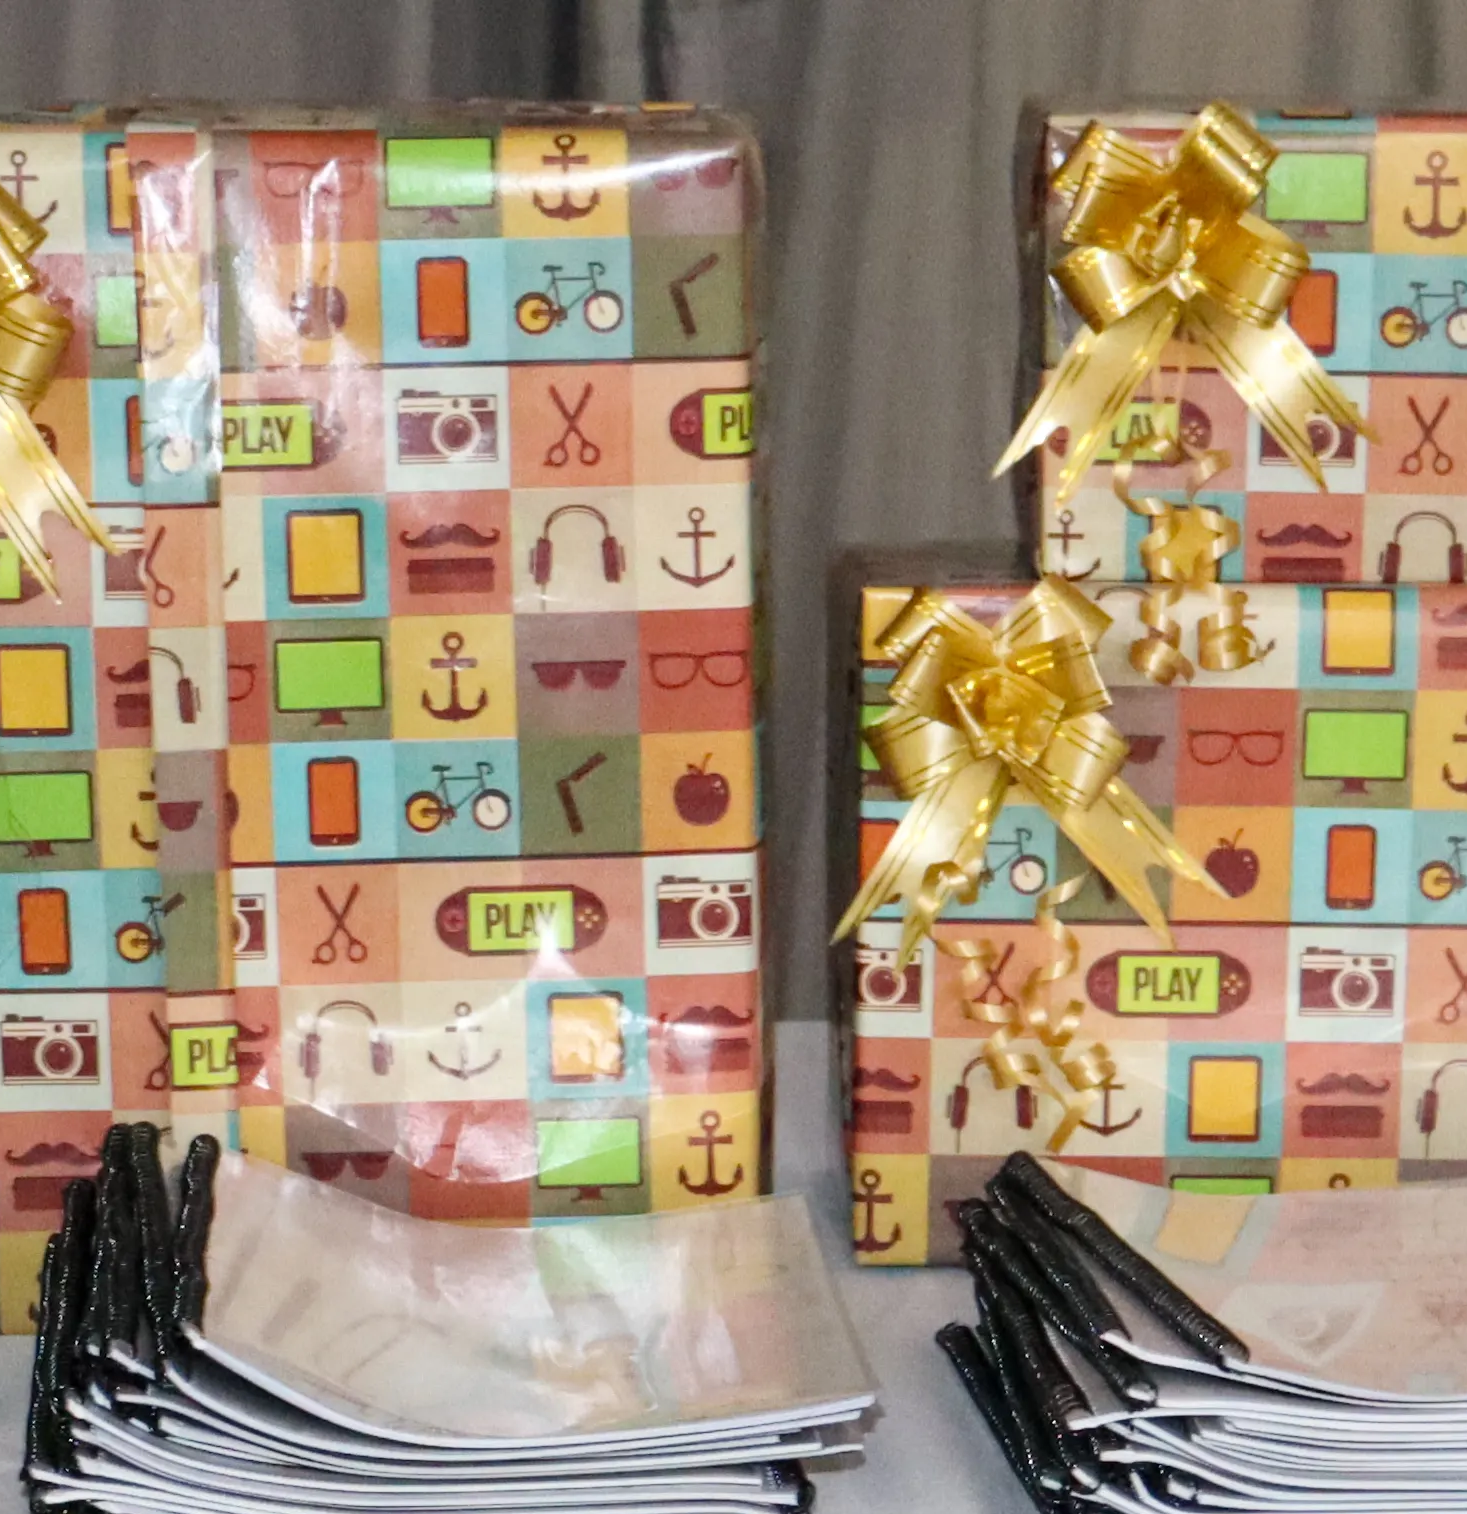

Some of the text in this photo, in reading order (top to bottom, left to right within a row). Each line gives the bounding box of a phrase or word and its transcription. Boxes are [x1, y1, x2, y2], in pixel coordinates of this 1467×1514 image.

[222, 415, 294, 455] PLAY
[719, 404, 750, 442] PL
[485, 902, 557, 940] PLAY
[1134, 966, 1203, 1002] PLAY
[187, 1037, 238, 1075] PLA
